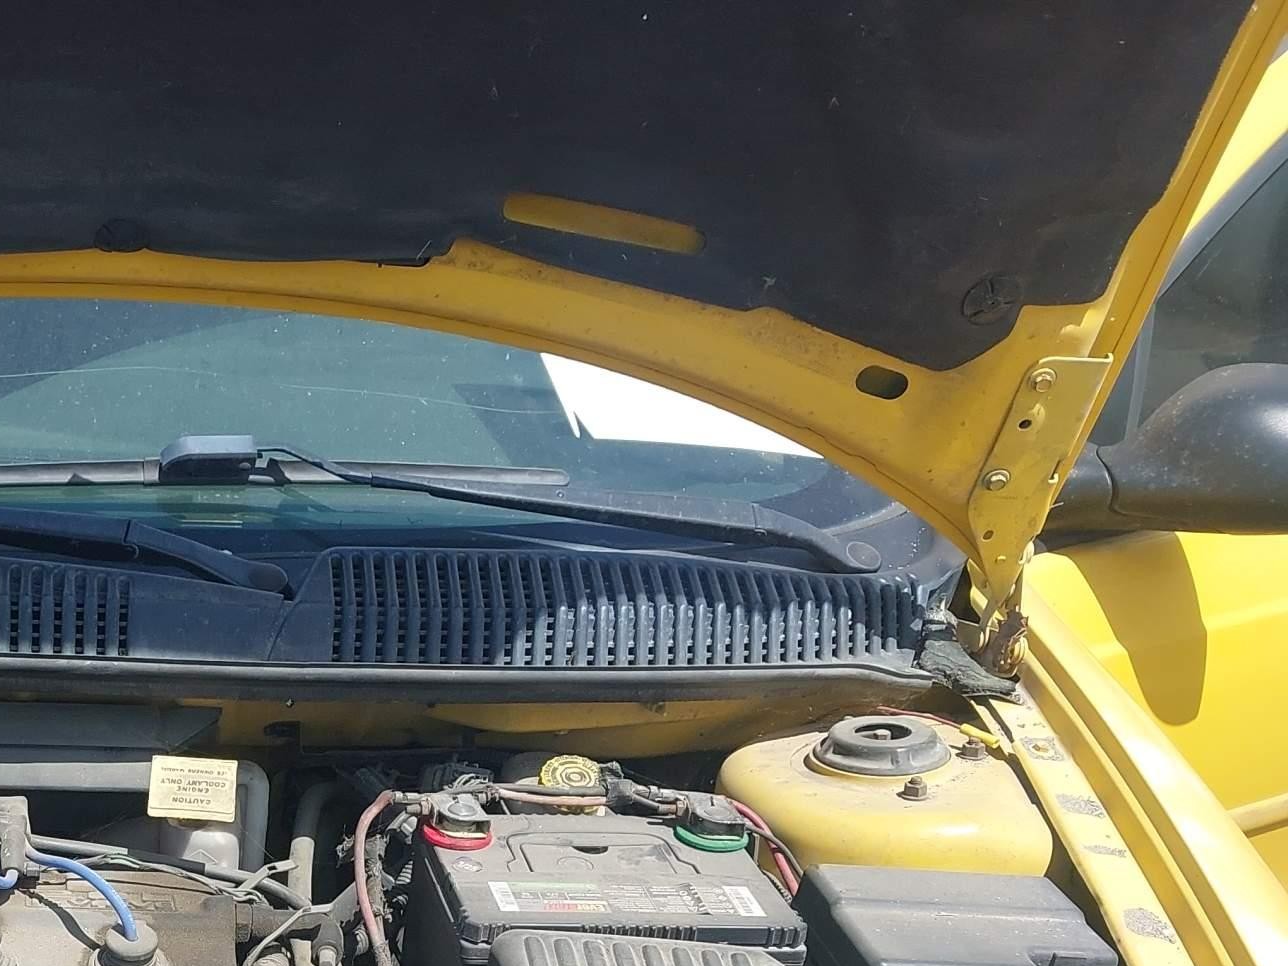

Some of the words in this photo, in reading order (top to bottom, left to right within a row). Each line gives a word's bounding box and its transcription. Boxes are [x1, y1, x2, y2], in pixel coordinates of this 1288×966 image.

[186, 780, 226, 788] COOLANT
[176, 786, 210, 794] ENGINE
[172, 796, 211, 805] CAUTION
